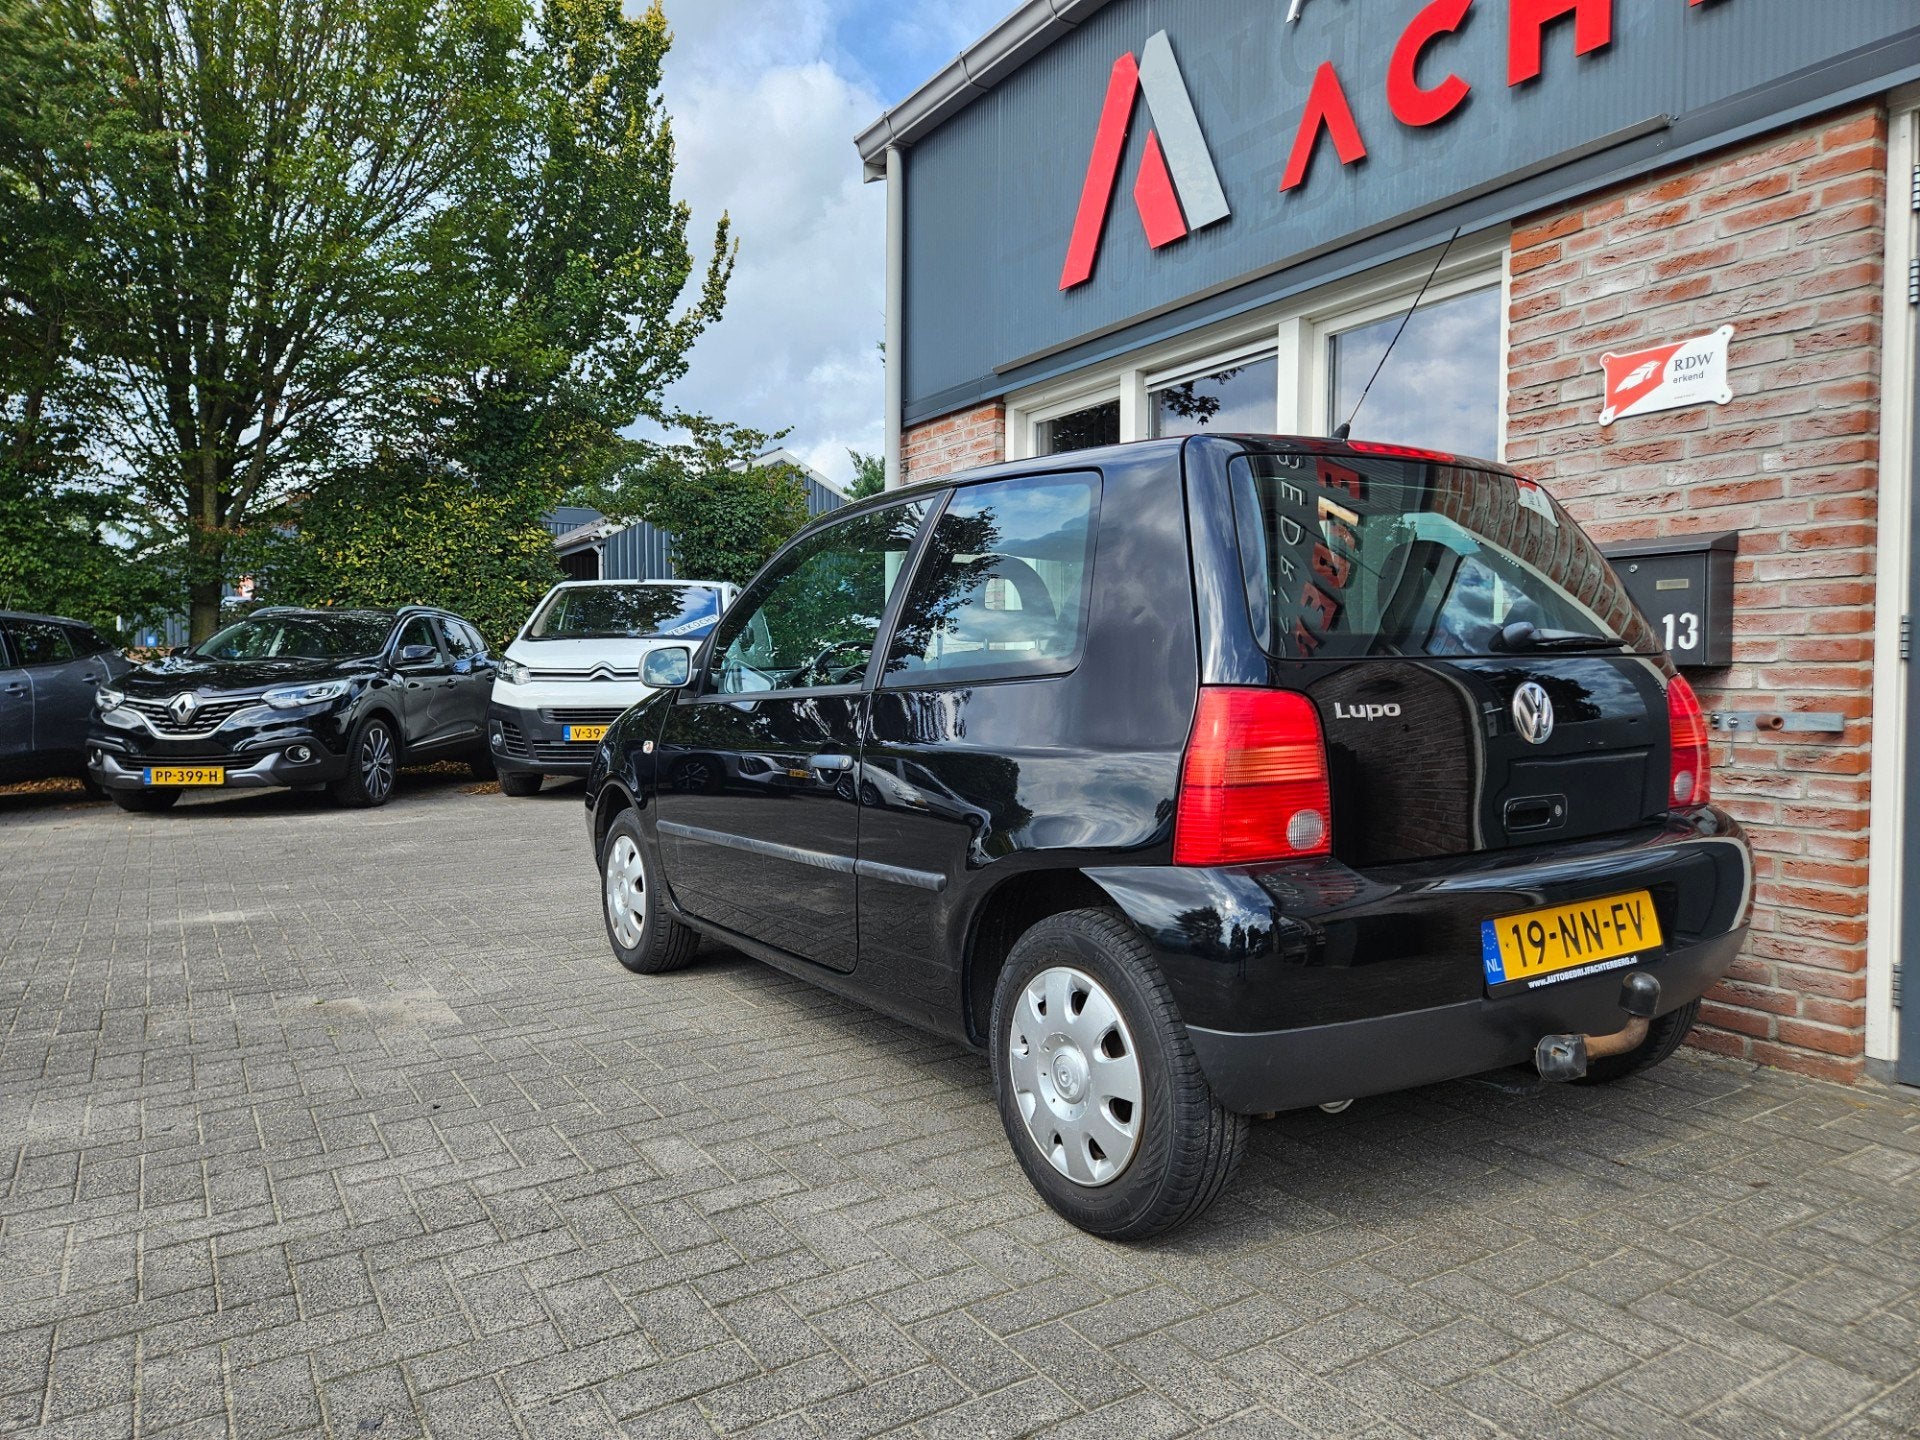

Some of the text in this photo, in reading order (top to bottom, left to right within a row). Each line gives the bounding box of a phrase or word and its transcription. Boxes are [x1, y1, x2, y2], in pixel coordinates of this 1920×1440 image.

[1280, 0, 1709, 192] ACH
[1674, 352, 1714, 371] RDW
[1673, 371, 1704, 384] erkend
[1662, 612, 1698, 650] 13
[1334, 702, 1401, 721] Lupo
[574, 728, 609, 739] V-39-
[155, 771, 218, 782] PP-399-H
[1512, 900, 1643, 967] 19-NN-FV
[1486, 958, 1502, 974] NL
